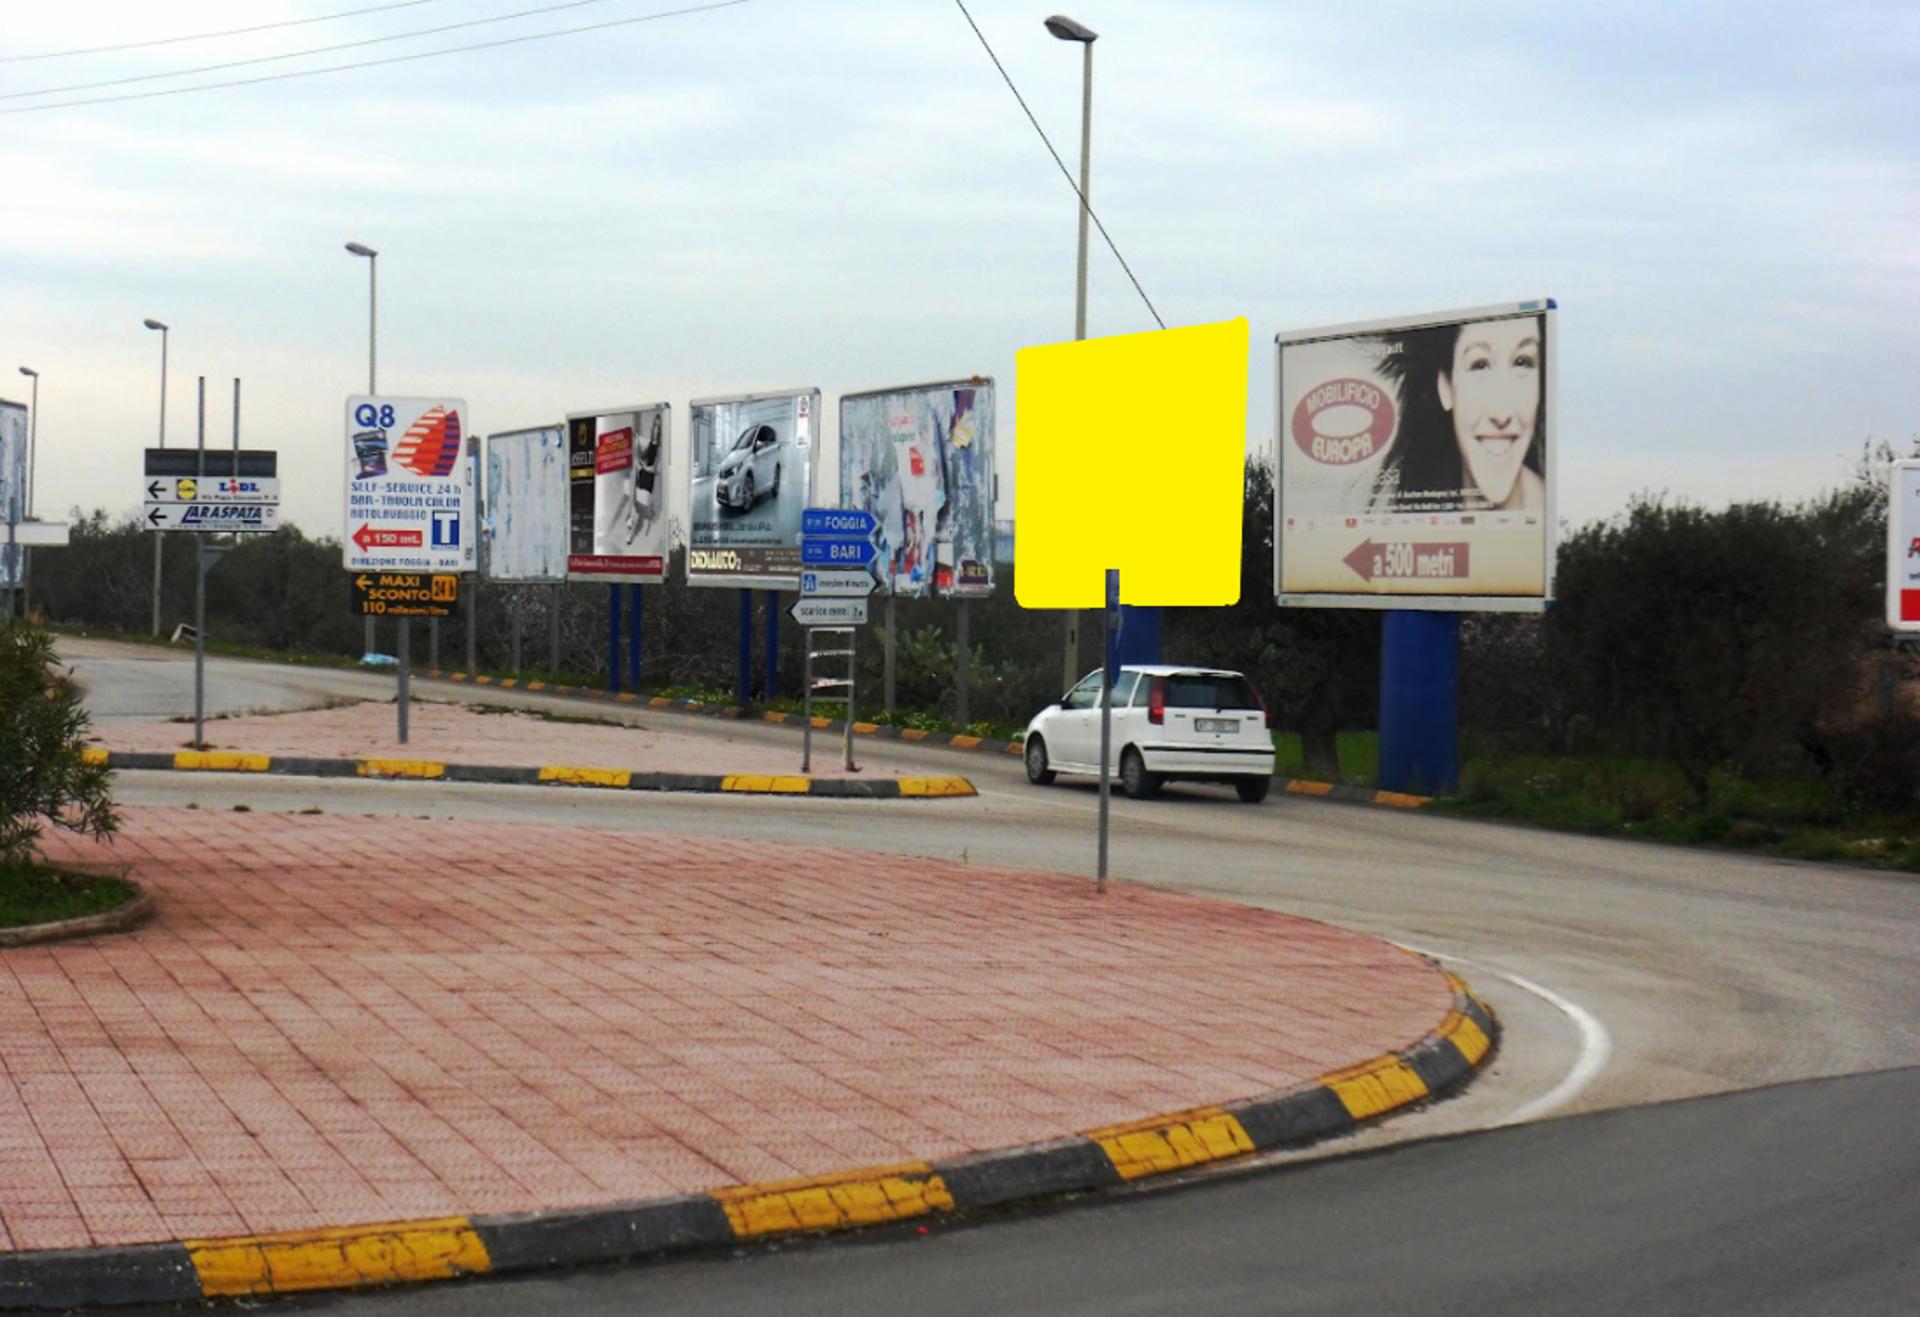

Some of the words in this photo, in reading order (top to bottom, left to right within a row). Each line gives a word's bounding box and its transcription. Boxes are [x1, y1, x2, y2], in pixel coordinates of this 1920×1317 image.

[1306, 383, 1380, 414] MOBILIFICIO
[355, 404, 395, 428] Q8
[1311, 432, 1373, 462] EUROPA
[824, 516, 868, 530] FOGGIA
[830, 544, 861, 559] BARI
[1373, 554, 1383, 576] a
[1385, 543, 1414, 576] 500
[1417, 548, 1454, 576] metri
[379, 575, 420, 587] MAXI
[368, 589, 431, 600] SCONTO
[362, 601, 386, 614] 110
